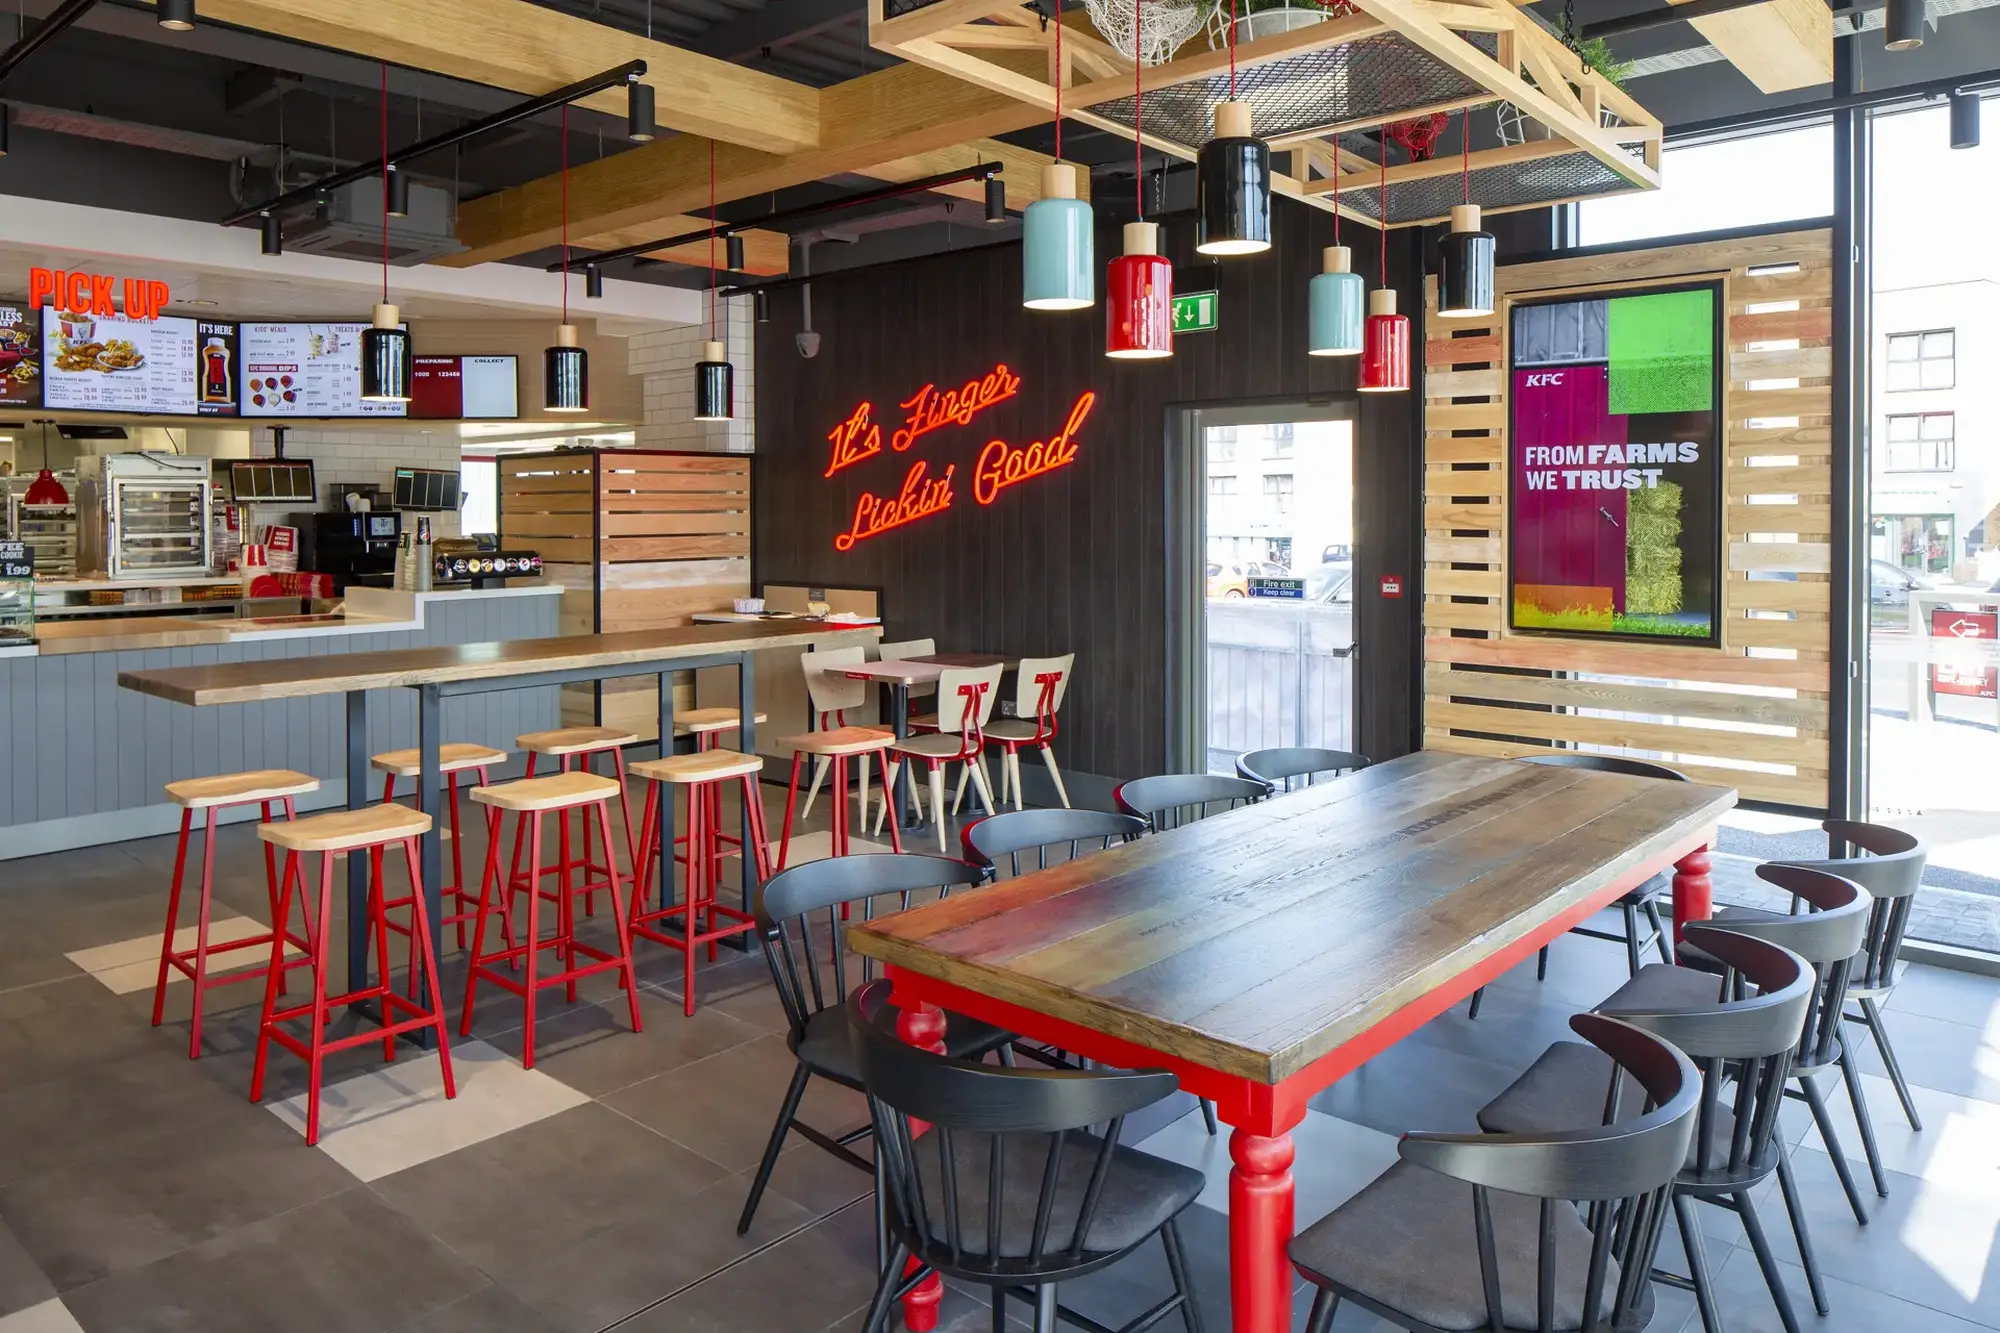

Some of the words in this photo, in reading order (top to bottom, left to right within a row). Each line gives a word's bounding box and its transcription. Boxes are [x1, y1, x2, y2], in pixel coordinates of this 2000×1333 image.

[30, 267, 115, 316] PICK
[123, 278, 169, 320] UP
[199, 323, 213, 334] IT'S
[214, 325, 233, 336] HERE
[1525, 373, 1565, 388] KFC
[825, 402, 880, 478] It's
[892, 365, 1020, 451] Finger
[1525, 445, 1584, 466] FROM
[1588, 442, 1699, 465] FARMS
[835, 461, 955, 551] Lickin'
[974, 392, 1094, 504] Good
[1526, 470, 1558, 490] WE
[1561, 469, 1663, 490] TRUST
[1263, 580, 1279, 588] Fire
